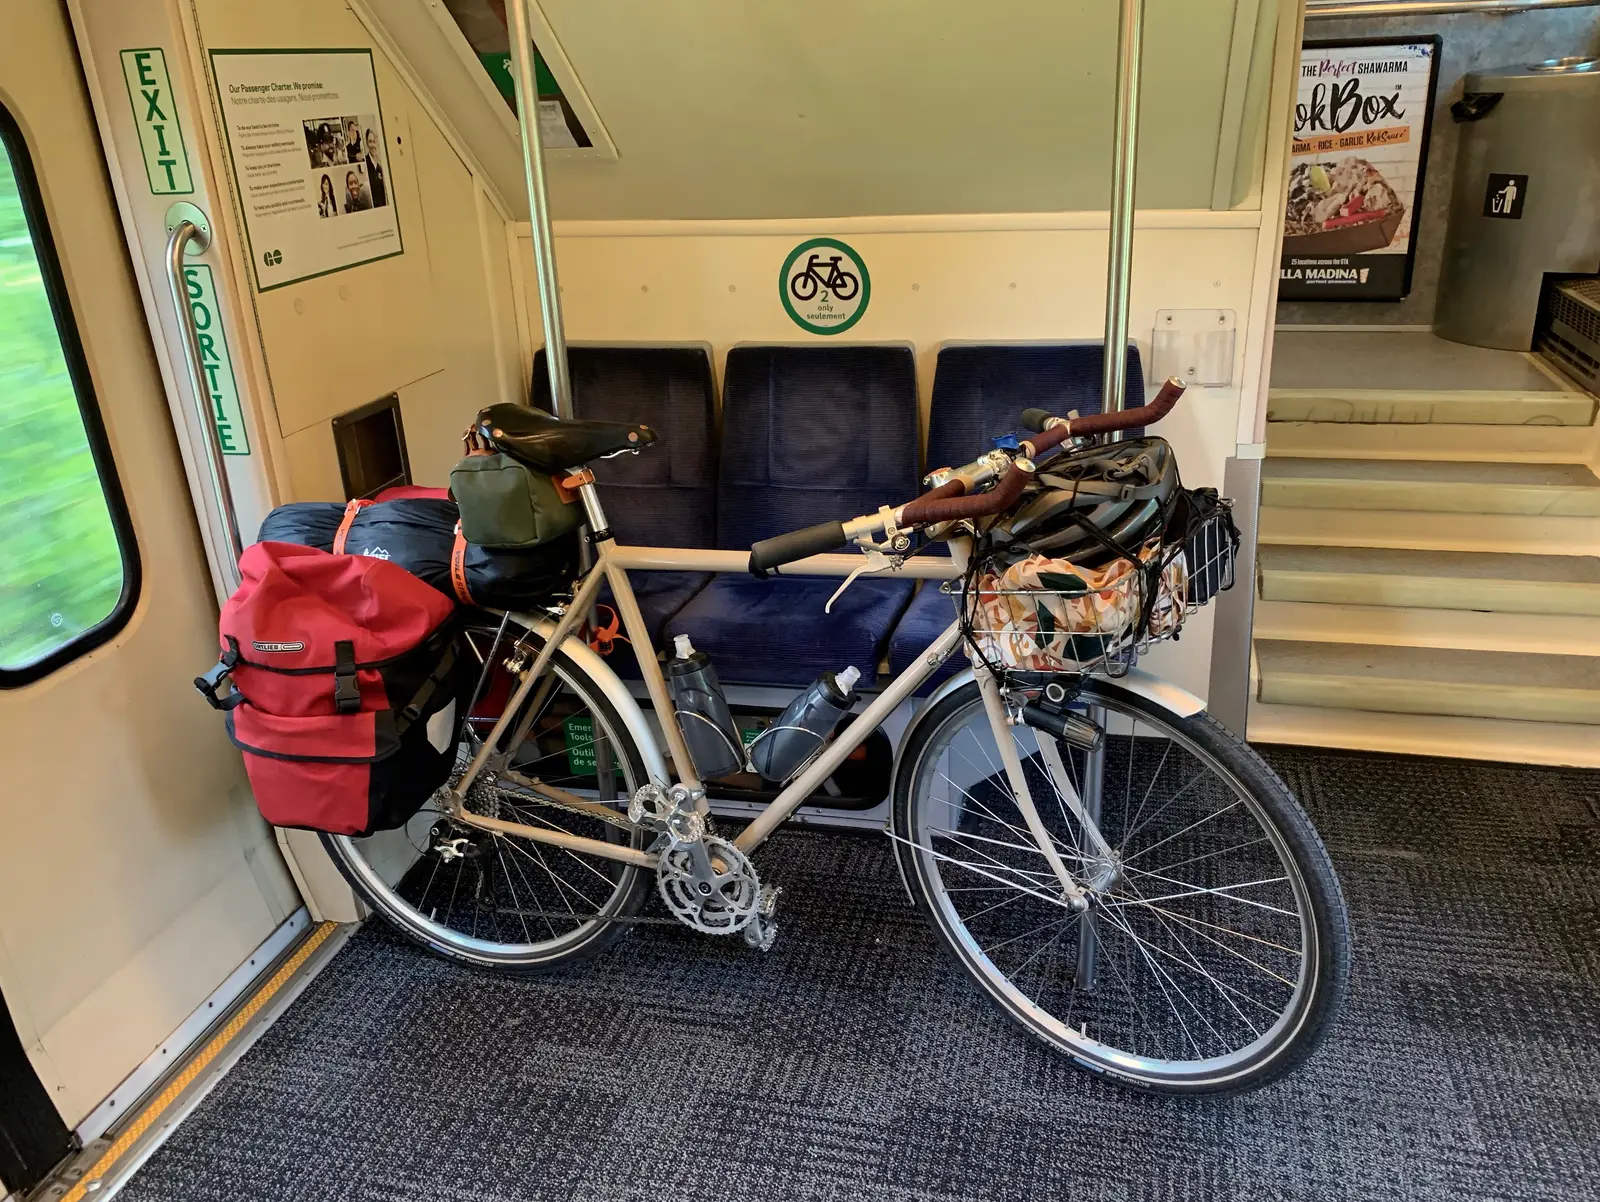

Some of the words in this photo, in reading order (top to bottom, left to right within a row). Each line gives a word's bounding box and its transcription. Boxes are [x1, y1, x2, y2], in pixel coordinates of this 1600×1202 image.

[1302, 65, 1317, 77] THE
[1318, 59, 1357, 78] Perfect
[1357, 61, 1408, 74] SHAWARMA
[229, 84, 240, 93] Our
[240, 83, 270, 94] Passenger
[270, 82, 293, 92] Charter.
[292, 81, 302, 90] We
[230, 96, 247, 105] Notre
[248, 96, 265, 105] charte
[266, 95, 276, 104] des
[1293, 77, 1406, 134] okBox
[134, 52, 177, 191] EXIT
[1292, 142, 1311, 153] ARMA
[1318, 139, 1333, 150] RICE
[1339, 135, 1364, 148] GARLIC
[1280, 268, 1303, 279] LLA
[1305, 268, 1358, 279] MADINA
[820, 289, 829, 303] 2
[817, 303, 834, 313] only
[806, 312, 846, 320] seulement
[184, 269, 237, 451] SORTIE
[567, 723, 592, 732] Emer
[569, 732, 593, 741] Tools
[572, 748, 595, 757] Outil
[573, 757, 585, 766] de
